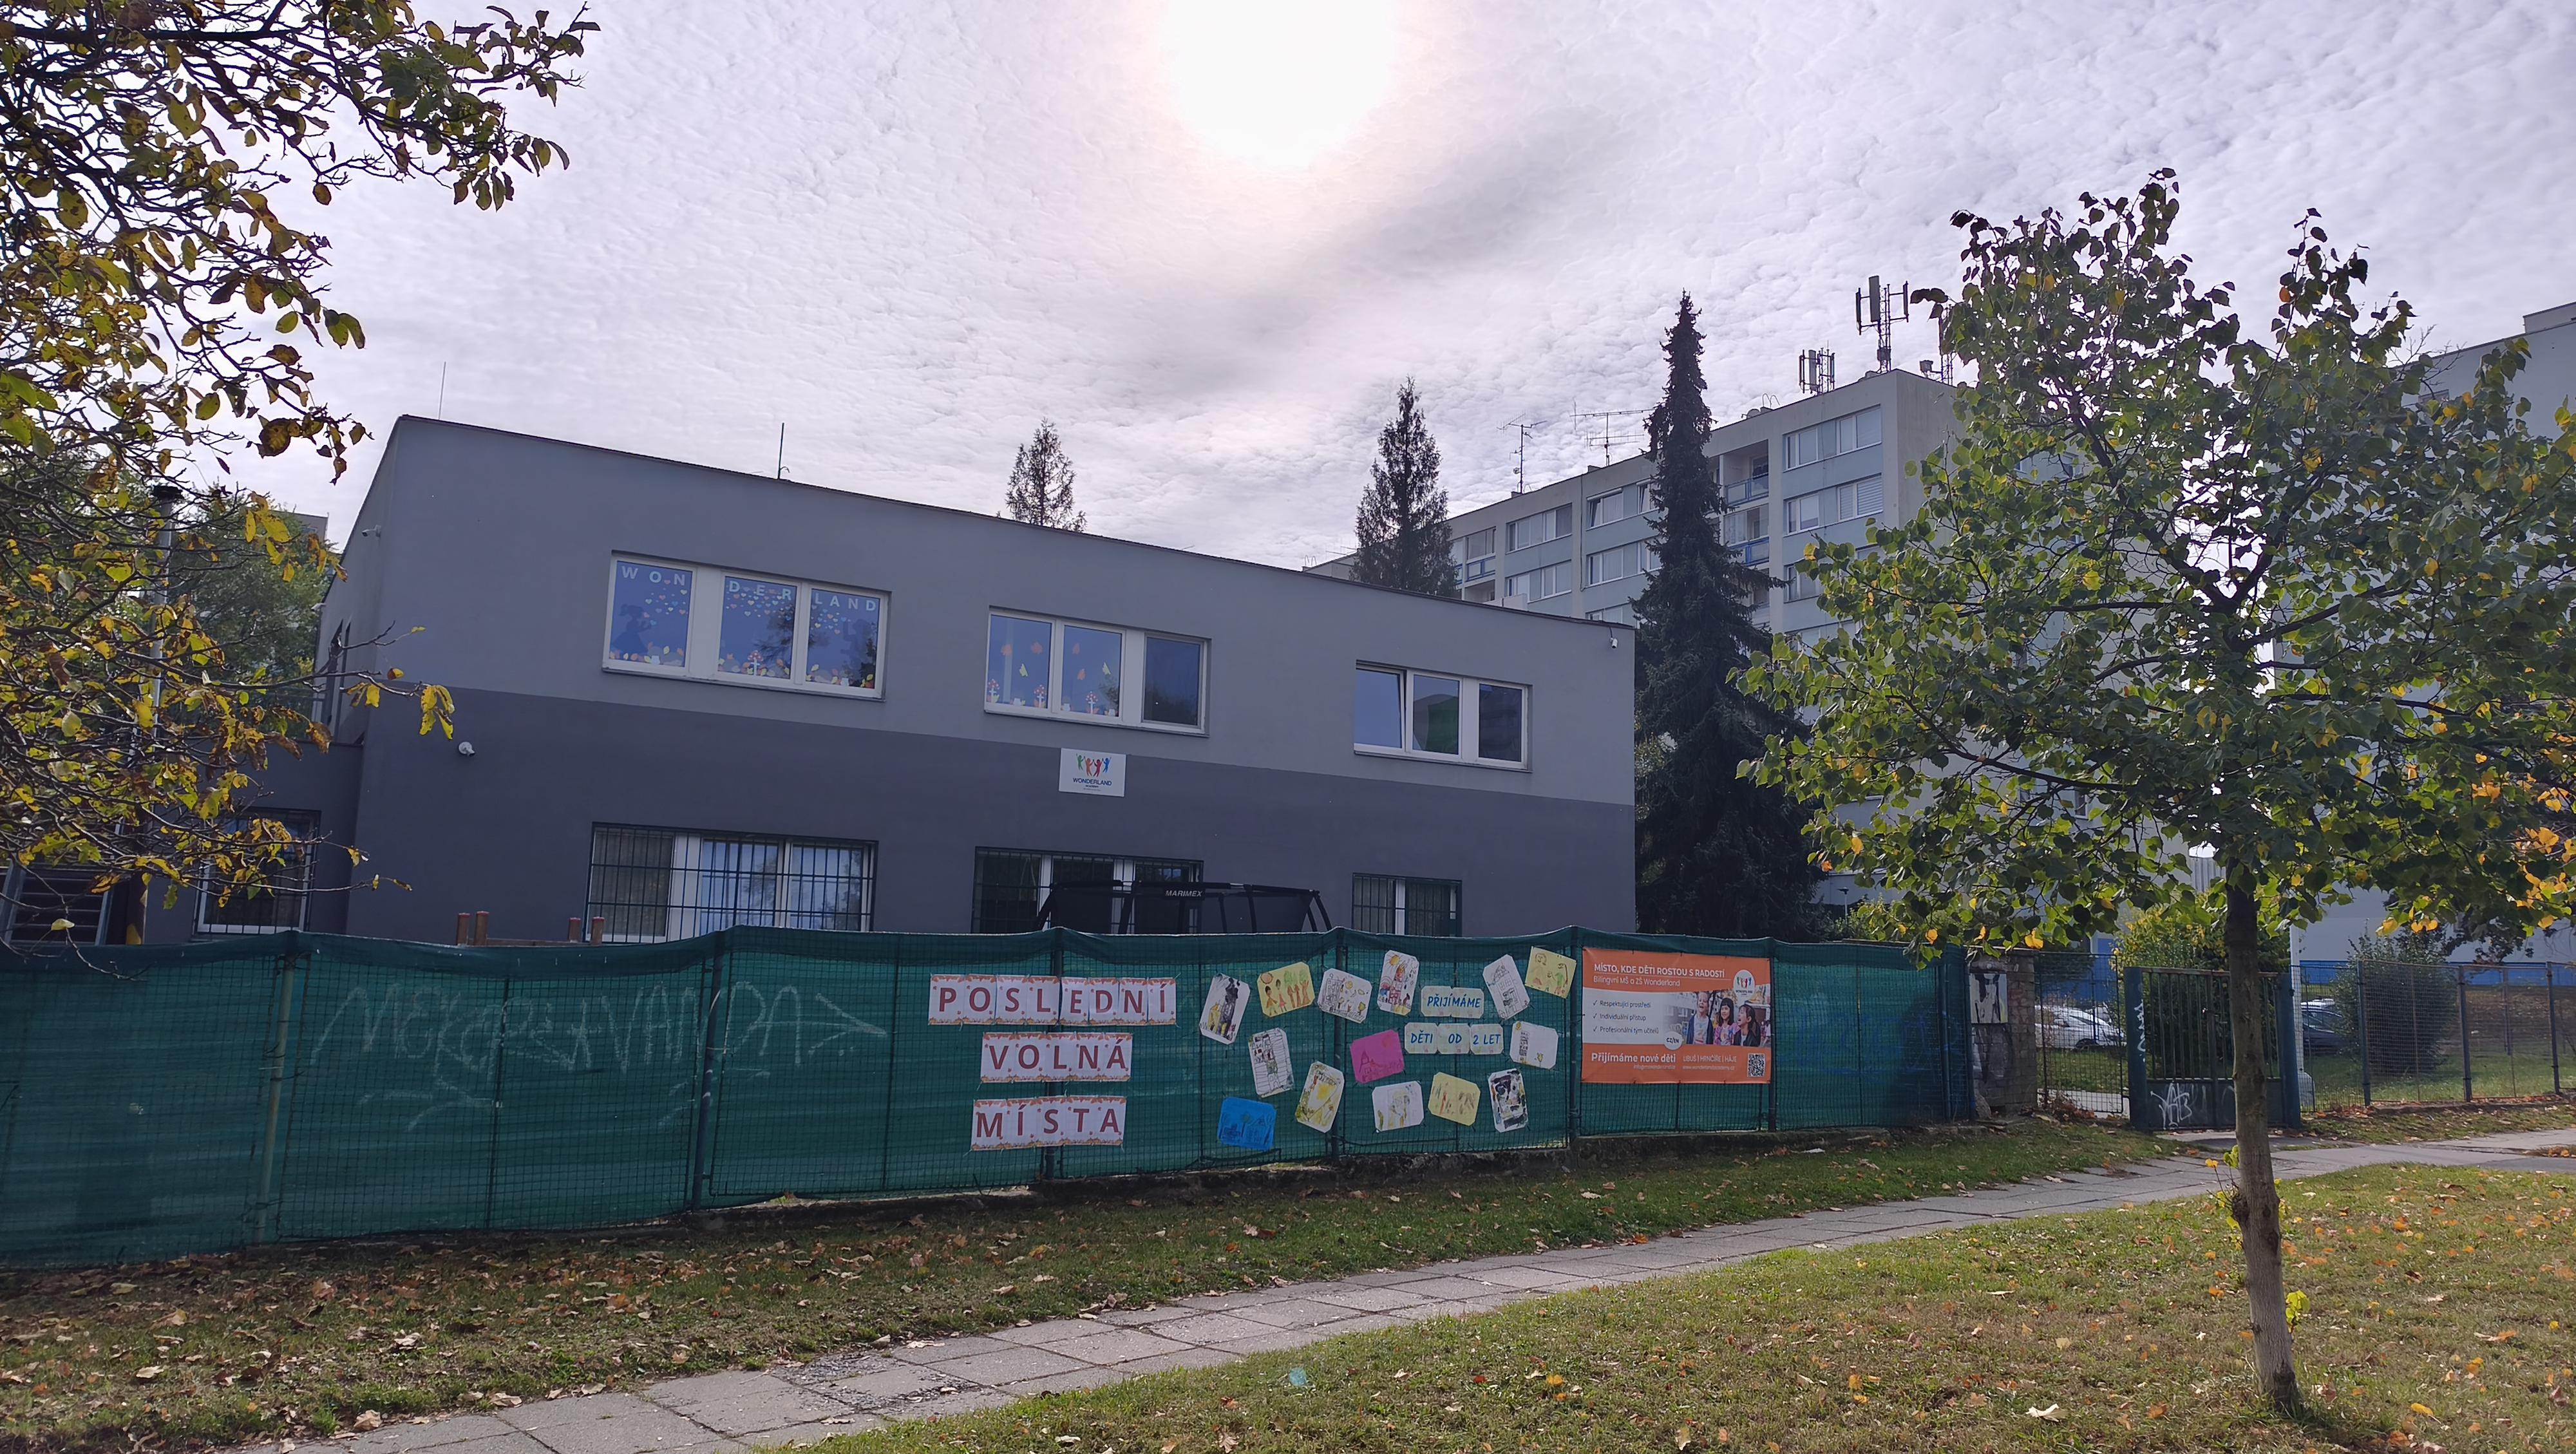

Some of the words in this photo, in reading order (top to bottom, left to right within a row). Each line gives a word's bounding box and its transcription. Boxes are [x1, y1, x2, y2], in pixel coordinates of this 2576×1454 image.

[1073, 777, 1112, 786] WONDERLAND
[1594, 962, 1620, 974] MÍSTO,
[1638, 965, 1655, 975] DĚTI
[1657, 968, 1687, 977] ROSTOU
[1695, 968, 1725, 978] RADOSTÍ
[1593, 975, 1619, 985] Bilingvní
[1620, 976, 1629, 985] MŠ
[1643, 978, 1680, 987] Wonderland
[938, 983, 1166, 1014] POSLEDNÍ
[1427, 994, 1481, 1008] PŘIJÍMÁME
[1410, 1030, 1433, 1044] DĚTI
[1448, 1034, 1462, 1044] OD
[1473, 1035, 1479, 1045] 2
[1483, 1034, 1501, 1044] LET
[989, 1039, 1128, 1070] VOLNÁ
[1591, 1052, 1638, 1064] Přijímáme
[1640, 1053, 1660, 1062] nové
[1660, 1053, 1676, 1062] děti
[976, 1104, 1121, 1138] MÍSTA
